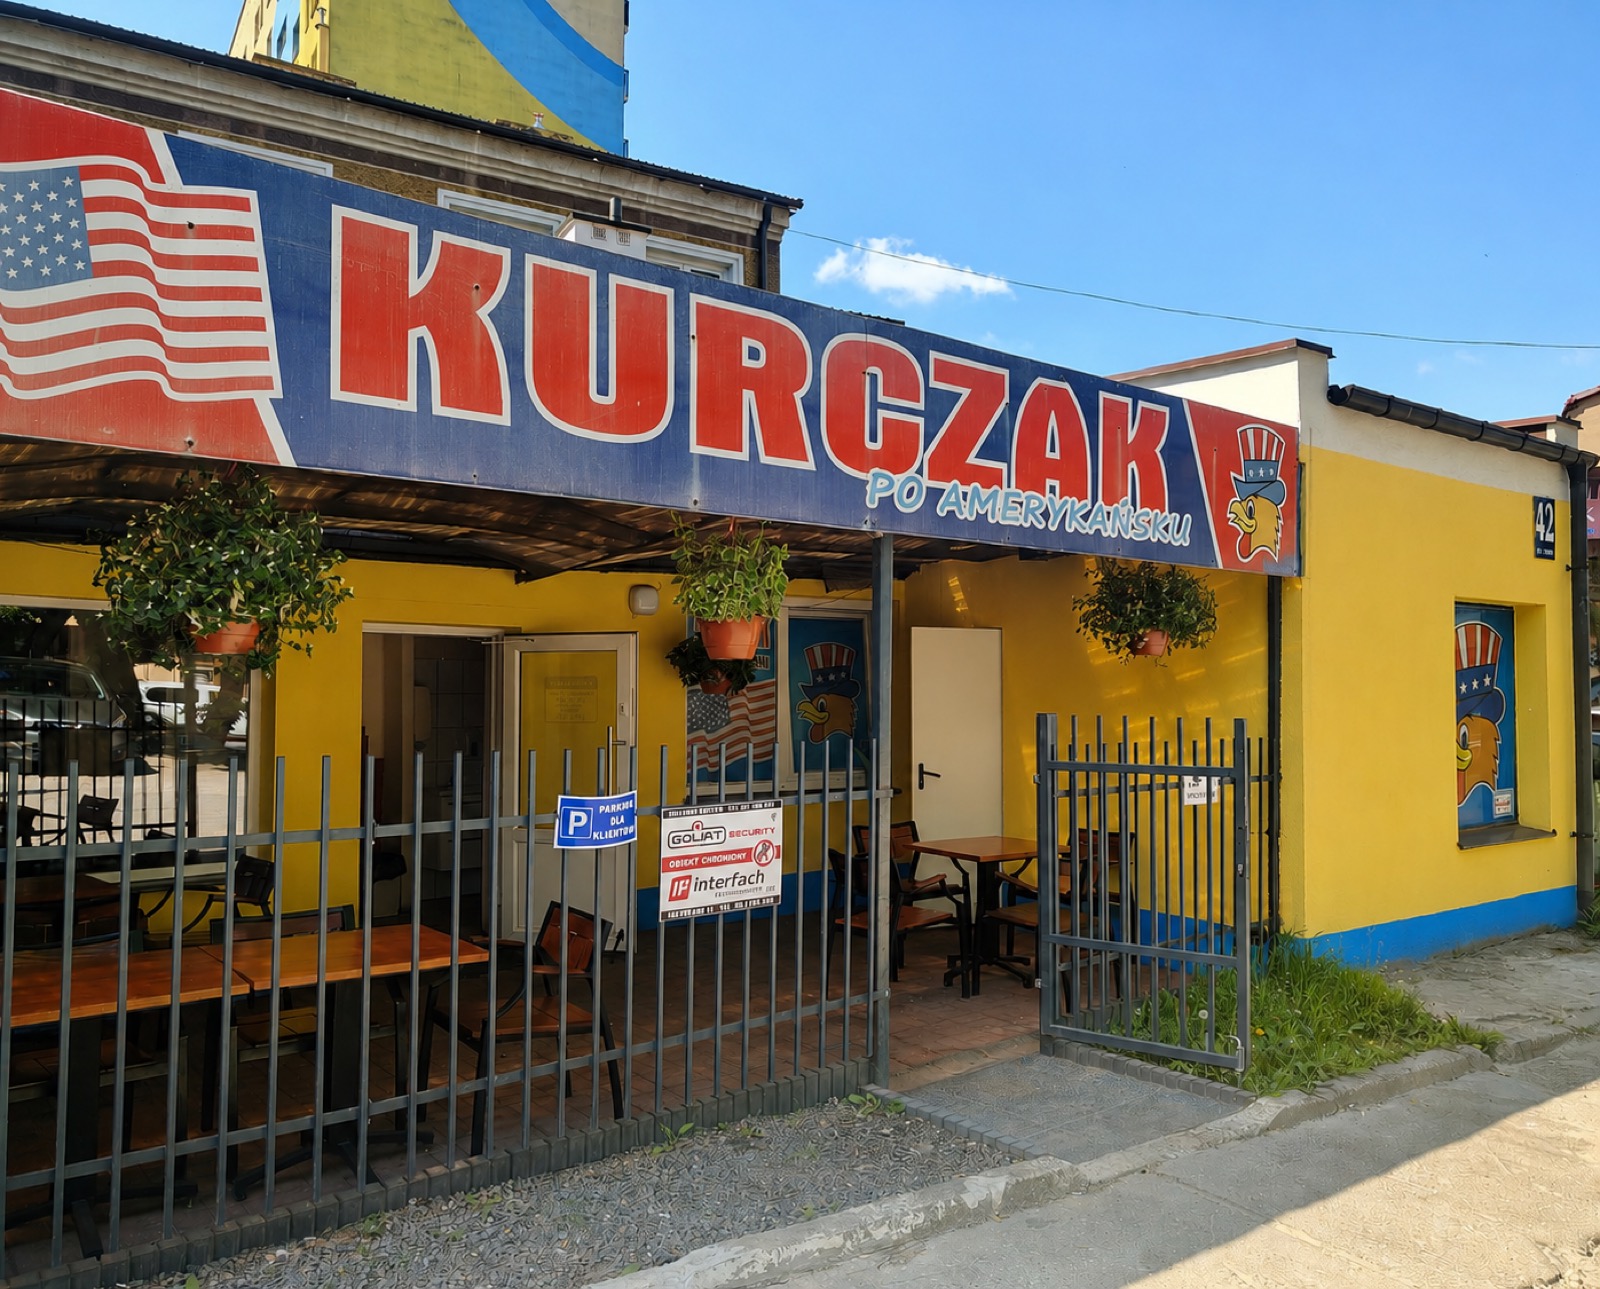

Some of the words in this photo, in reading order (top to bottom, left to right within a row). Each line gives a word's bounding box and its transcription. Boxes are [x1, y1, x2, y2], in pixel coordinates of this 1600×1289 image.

[330, 203, 1171, 513] KURCZAK
[865, 468, 925, 513] PO
[936, 480, 1192, 547] AMERYKAŃSKU
[1535, 502, 1554, 543] 42
[568, 810, 588, 836] P
[610, 815, 625, 827] DLA
[671, 830, 724, 845] GOLIAT
[728, 826, 775, 839] SECURITY
[693, 869, 765, 893] interfach
